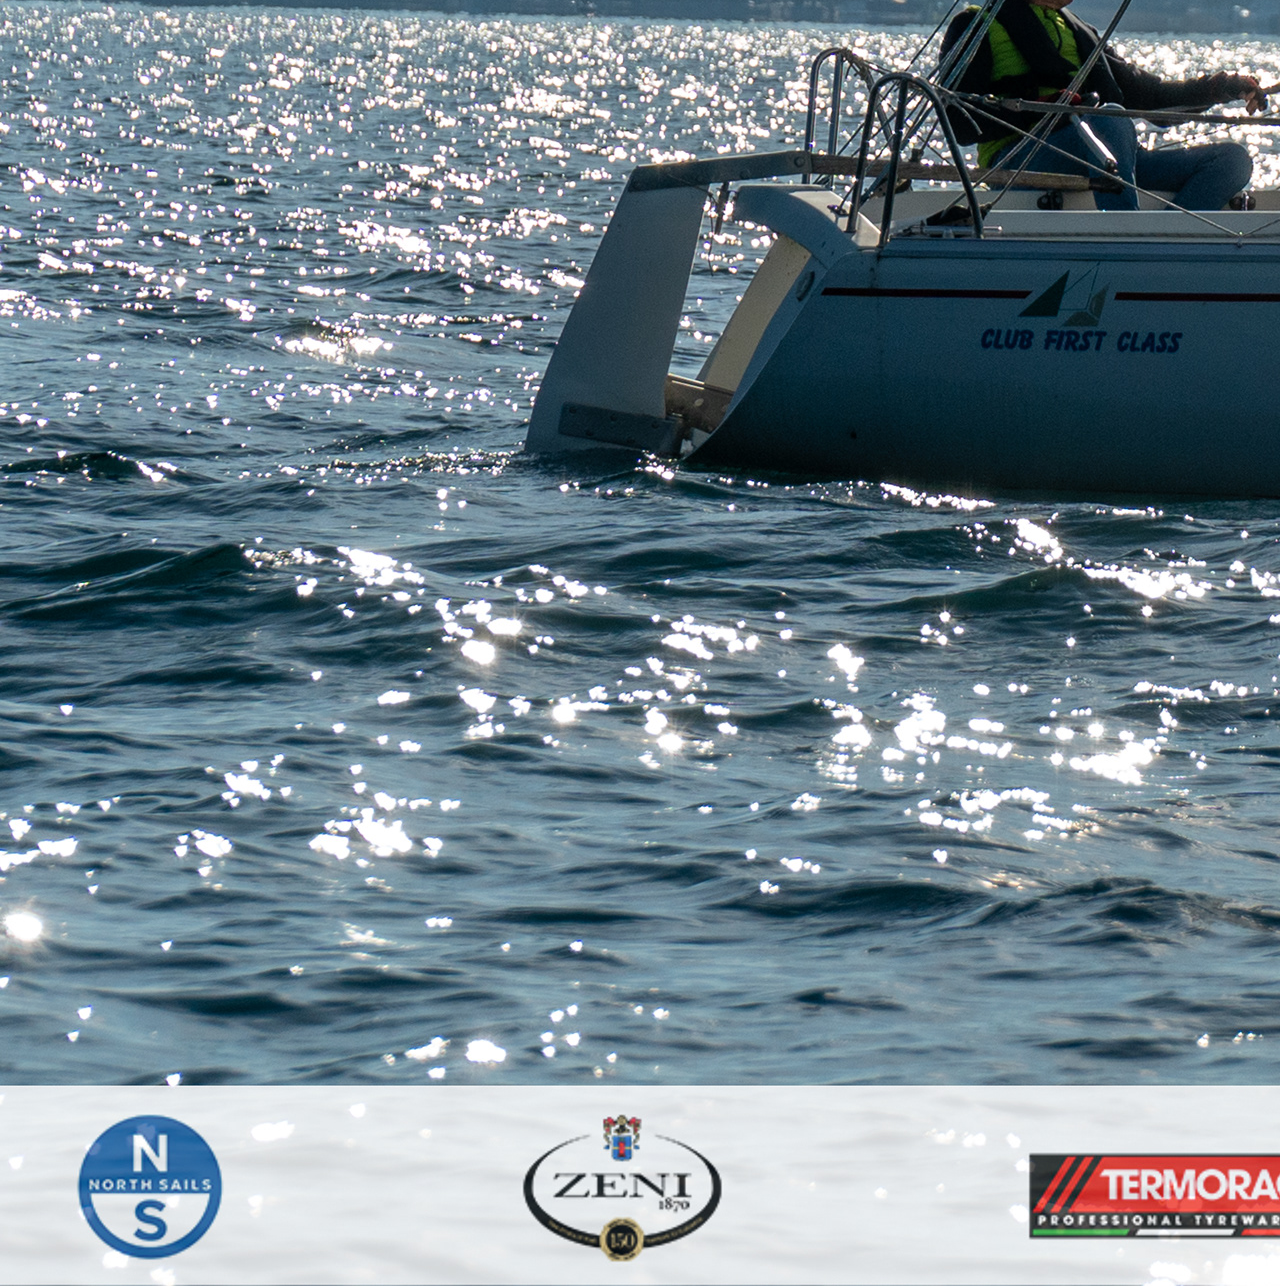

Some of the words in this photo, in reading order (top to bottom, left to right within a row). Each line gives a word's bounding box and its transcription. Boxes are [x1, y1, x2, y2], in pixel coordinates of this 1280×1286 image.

[981, 328, 1034, 350] CLUB
[1044, 329, 1107, 352] FIRST
[1117, 331, 1183, 353] CLASS
